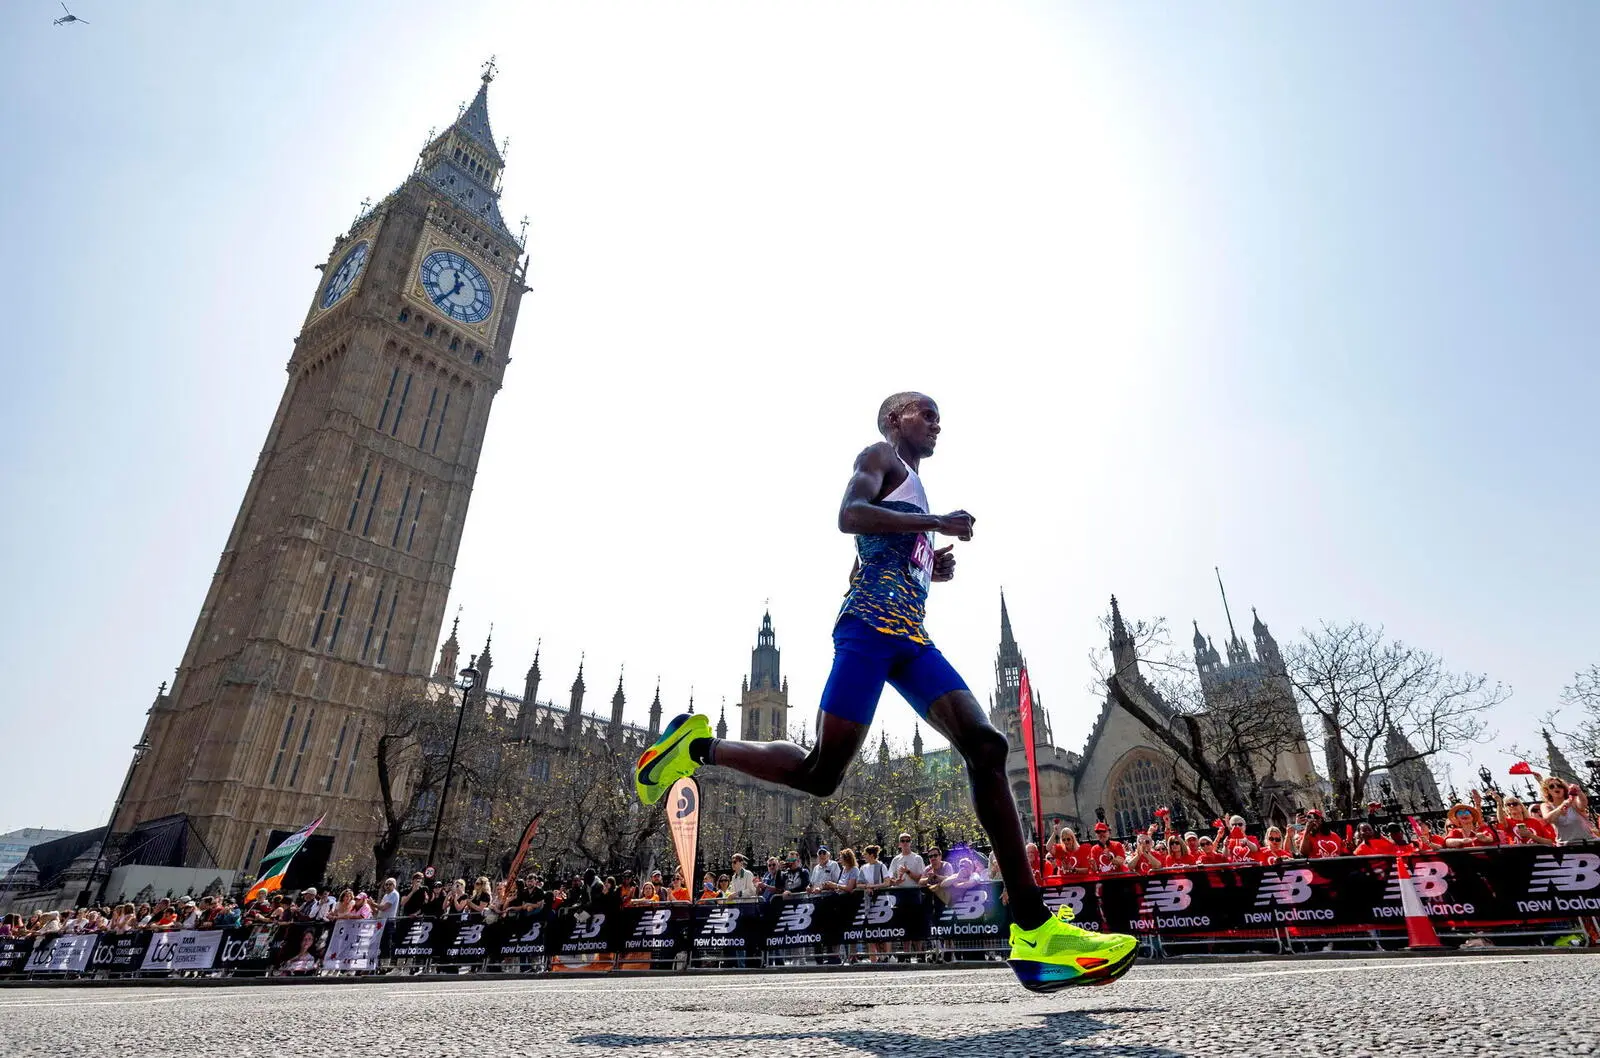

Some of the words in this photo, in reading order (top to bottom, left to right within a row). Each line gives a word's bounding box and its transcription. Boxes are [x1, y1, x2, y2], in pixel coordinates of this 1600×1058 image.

[1373, 905, 1404, 918] new
[1423, 902, 1475, 916] alance
[1517, 900, 1552, 912] new
[1244, 912, 1272, 923] new
[1274, 908, 1334, 922] balance
[1129, 919, 1154, 930] new
[1157, 915, 1210, 928] balance
[844, 930, 864, 940] new
[865, 927, 905, 938] balance
[931, 926, 952, 935] new
[954, 923, 999, 935] balance
[625, 939, 641, 948] new
[642, 937, 674, 948] balance
[694, 938, 710, 947] new
[711, 936, 745, 946] balance
[766, 937, 783, 946] new
[785, 933, 821, 945] balance
[408, 947, 433, 955] balance
[459, 947, 485, 955] balance
[500, 946, 515, 954] new
[515, 944, 544, 953] balance
[562, 943, 577, 951] new
[577, 941, 607, 951] balance
